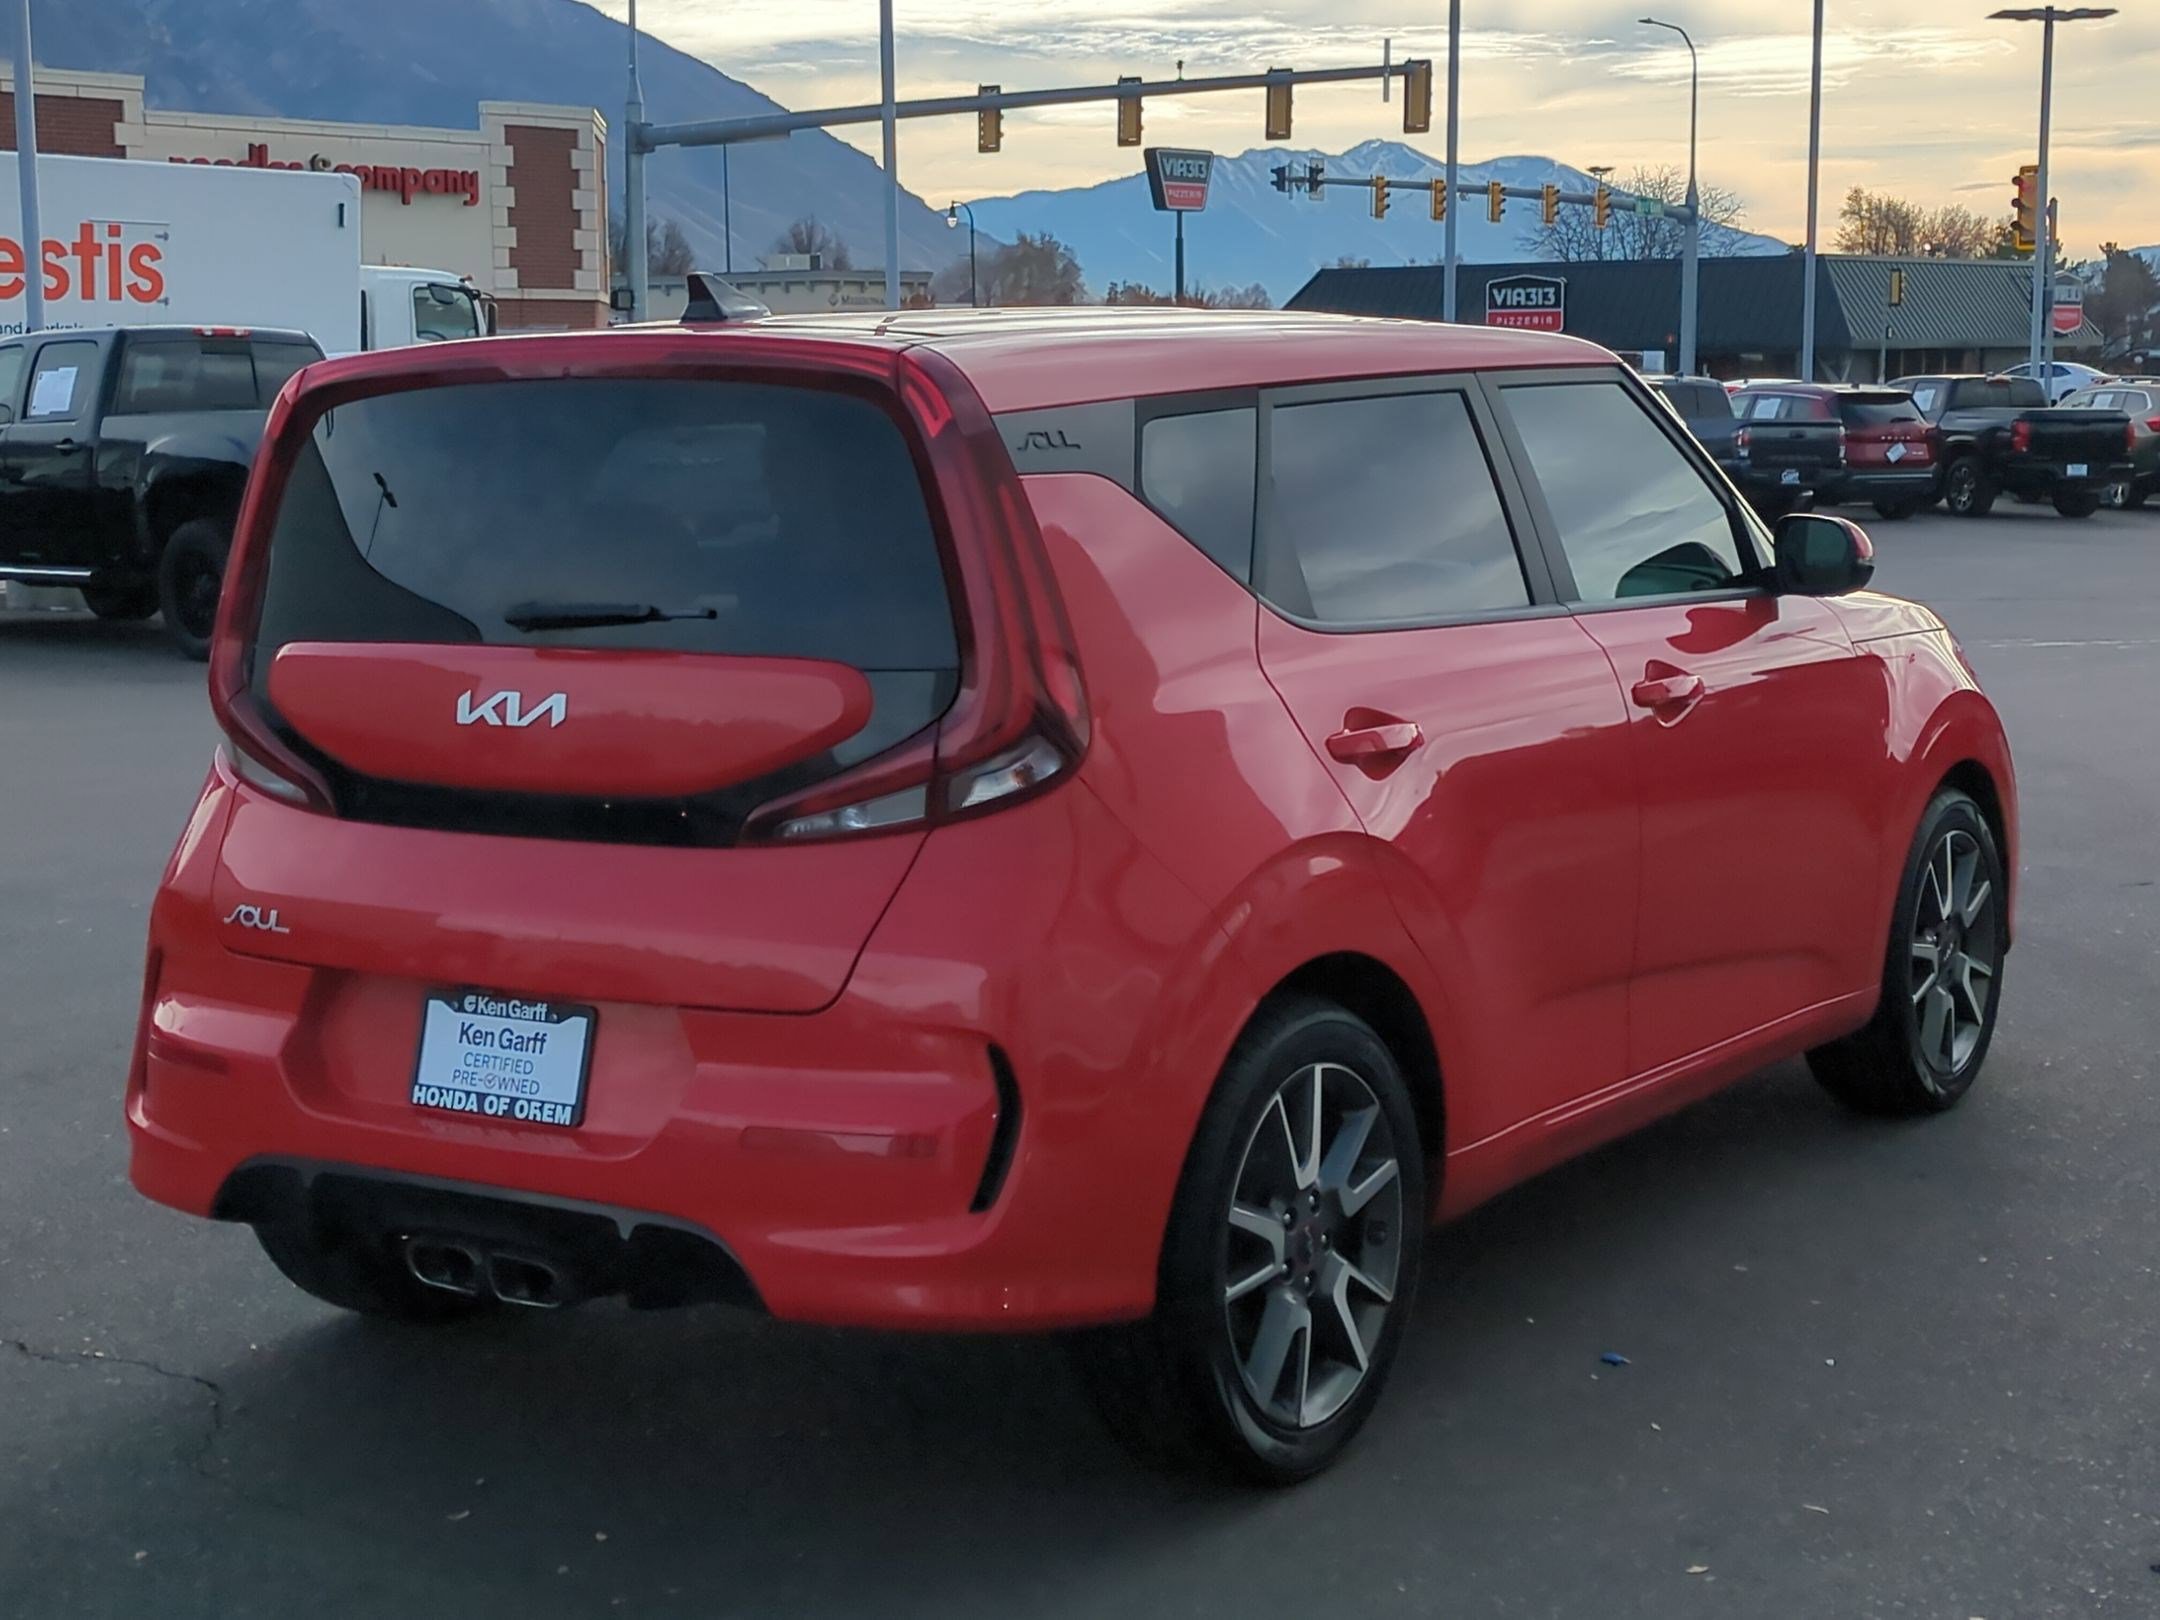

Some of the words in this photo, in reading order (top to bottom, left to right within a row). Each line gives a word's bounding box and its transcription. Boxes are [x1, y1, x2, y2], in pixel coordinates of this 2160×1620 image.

[1492, 287, 1556, 306] VIA313
[1496, 315, 1553, 325] PIZZERIA
[456, 689, 567, 728] KIA
[477, 997, 507, 1017] Ken
[508, 999, 547, 1021] Garff
[458, 1021, 495, 1048] Ken
[499, 1027, 547, 1054] Garff
[463, 1052, 534, 1075] CERTIFIED
[412, 1085, 478, 1113] HONDA
[484, 1096, 510, 1116] OF
[514, 1100, 572, 1126] OREM
